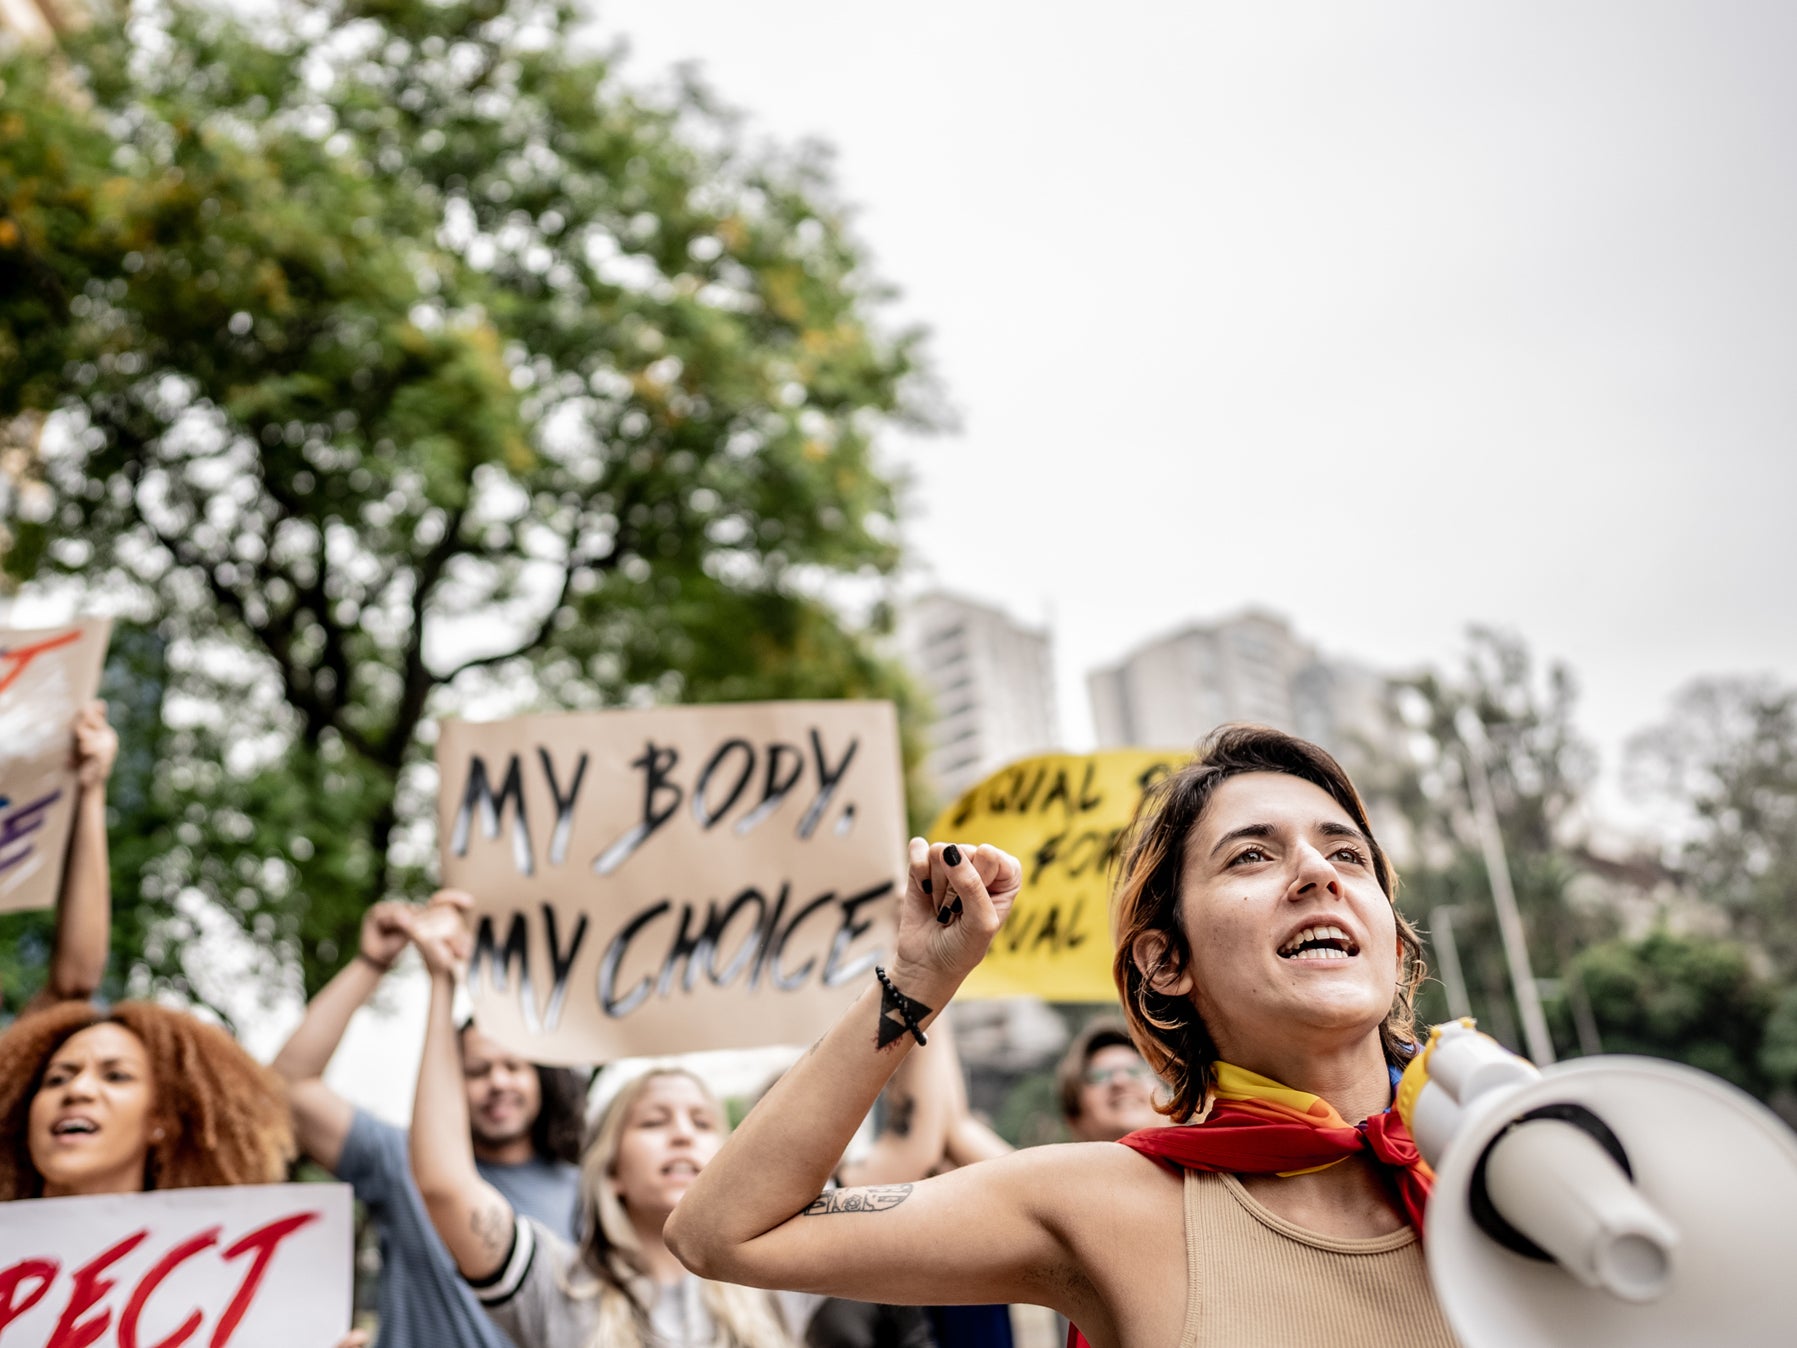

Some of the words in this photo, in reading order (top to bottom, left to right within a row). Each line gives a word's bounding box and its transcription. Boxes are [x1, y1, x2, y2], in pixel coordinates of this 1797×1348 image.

[450, 745, 590, 876] MY
[592, 726, 860, 875] BODY.
[468, 901, 589, 1035] MY
[598, 879, 895, 1019] CHOICE
